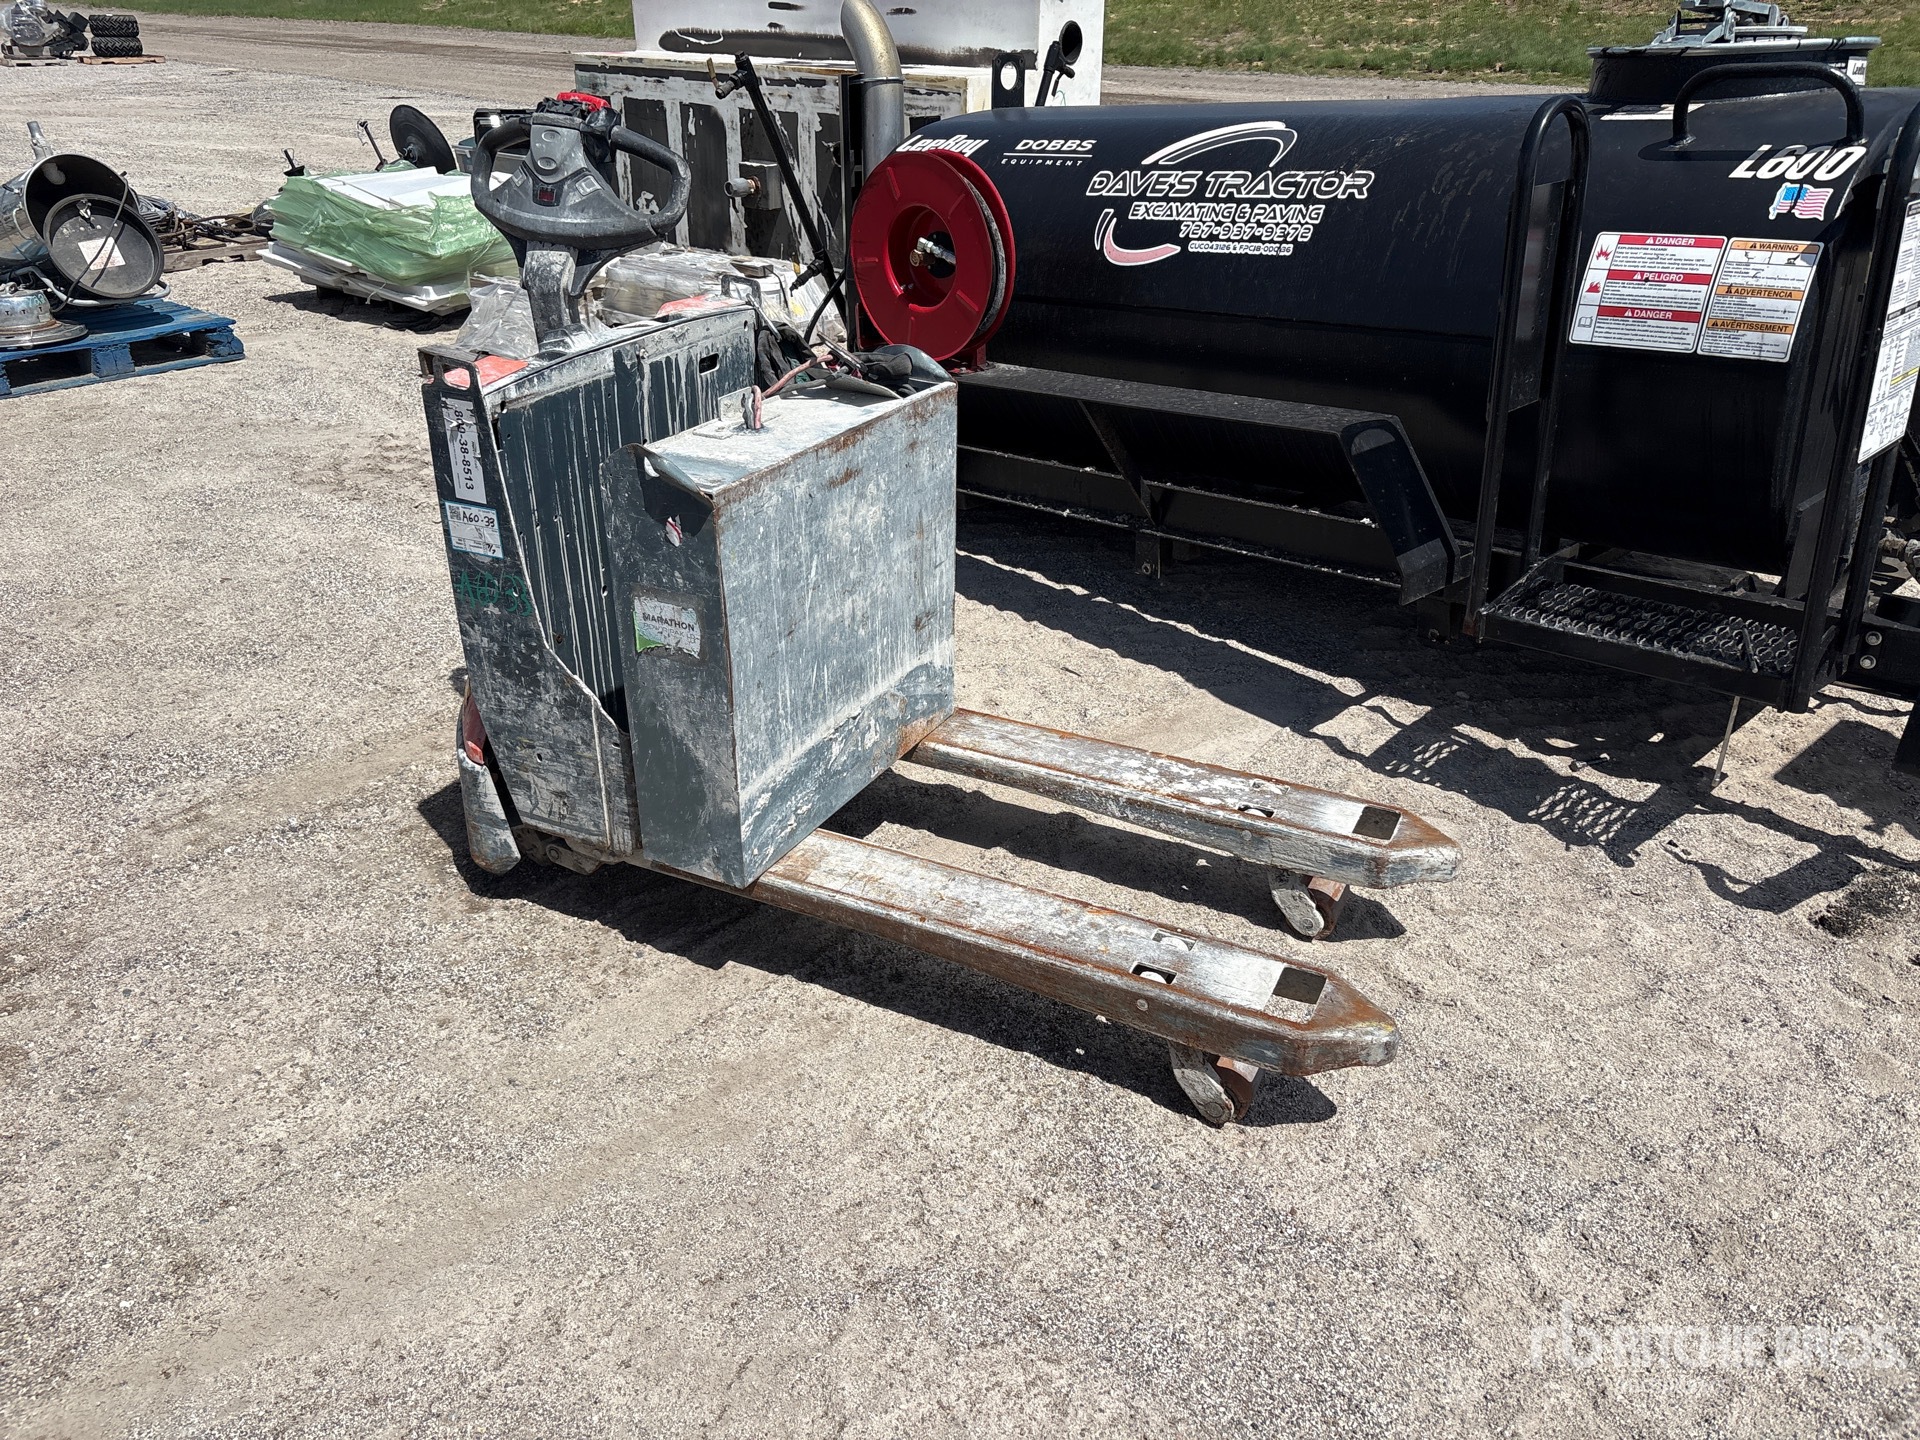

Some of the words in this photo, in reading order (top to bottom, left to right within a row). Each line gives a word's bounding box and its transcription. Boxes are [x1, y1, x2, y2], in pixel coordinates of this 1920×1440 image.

[1015, 139, 1097, 151] DOBBS
[1001, 158, 1083, 167] EQUIPMENT
[1728, 144, 1868, 182] L600
[1086, 170, 1202, 197] DAVE'S
[1205, 170, 1375, 198] TRACTOR
[1129, 202, 1236, 220] EXCAVATING
[1236, 204, 1252, 221] &
[1251, 204, 1326, 224] PAVING
[1655, 237, 1695, 246] DANGER
[1759, 243, 1799, 252] WARNING
[1643, 272, 1684, 282] PELIGRO
[1734, 288, 1793, 299] ADVERTENCIA
[1634, 310, 1672, 320] DANGER
[642, 612, 694, 632] MARATHON
